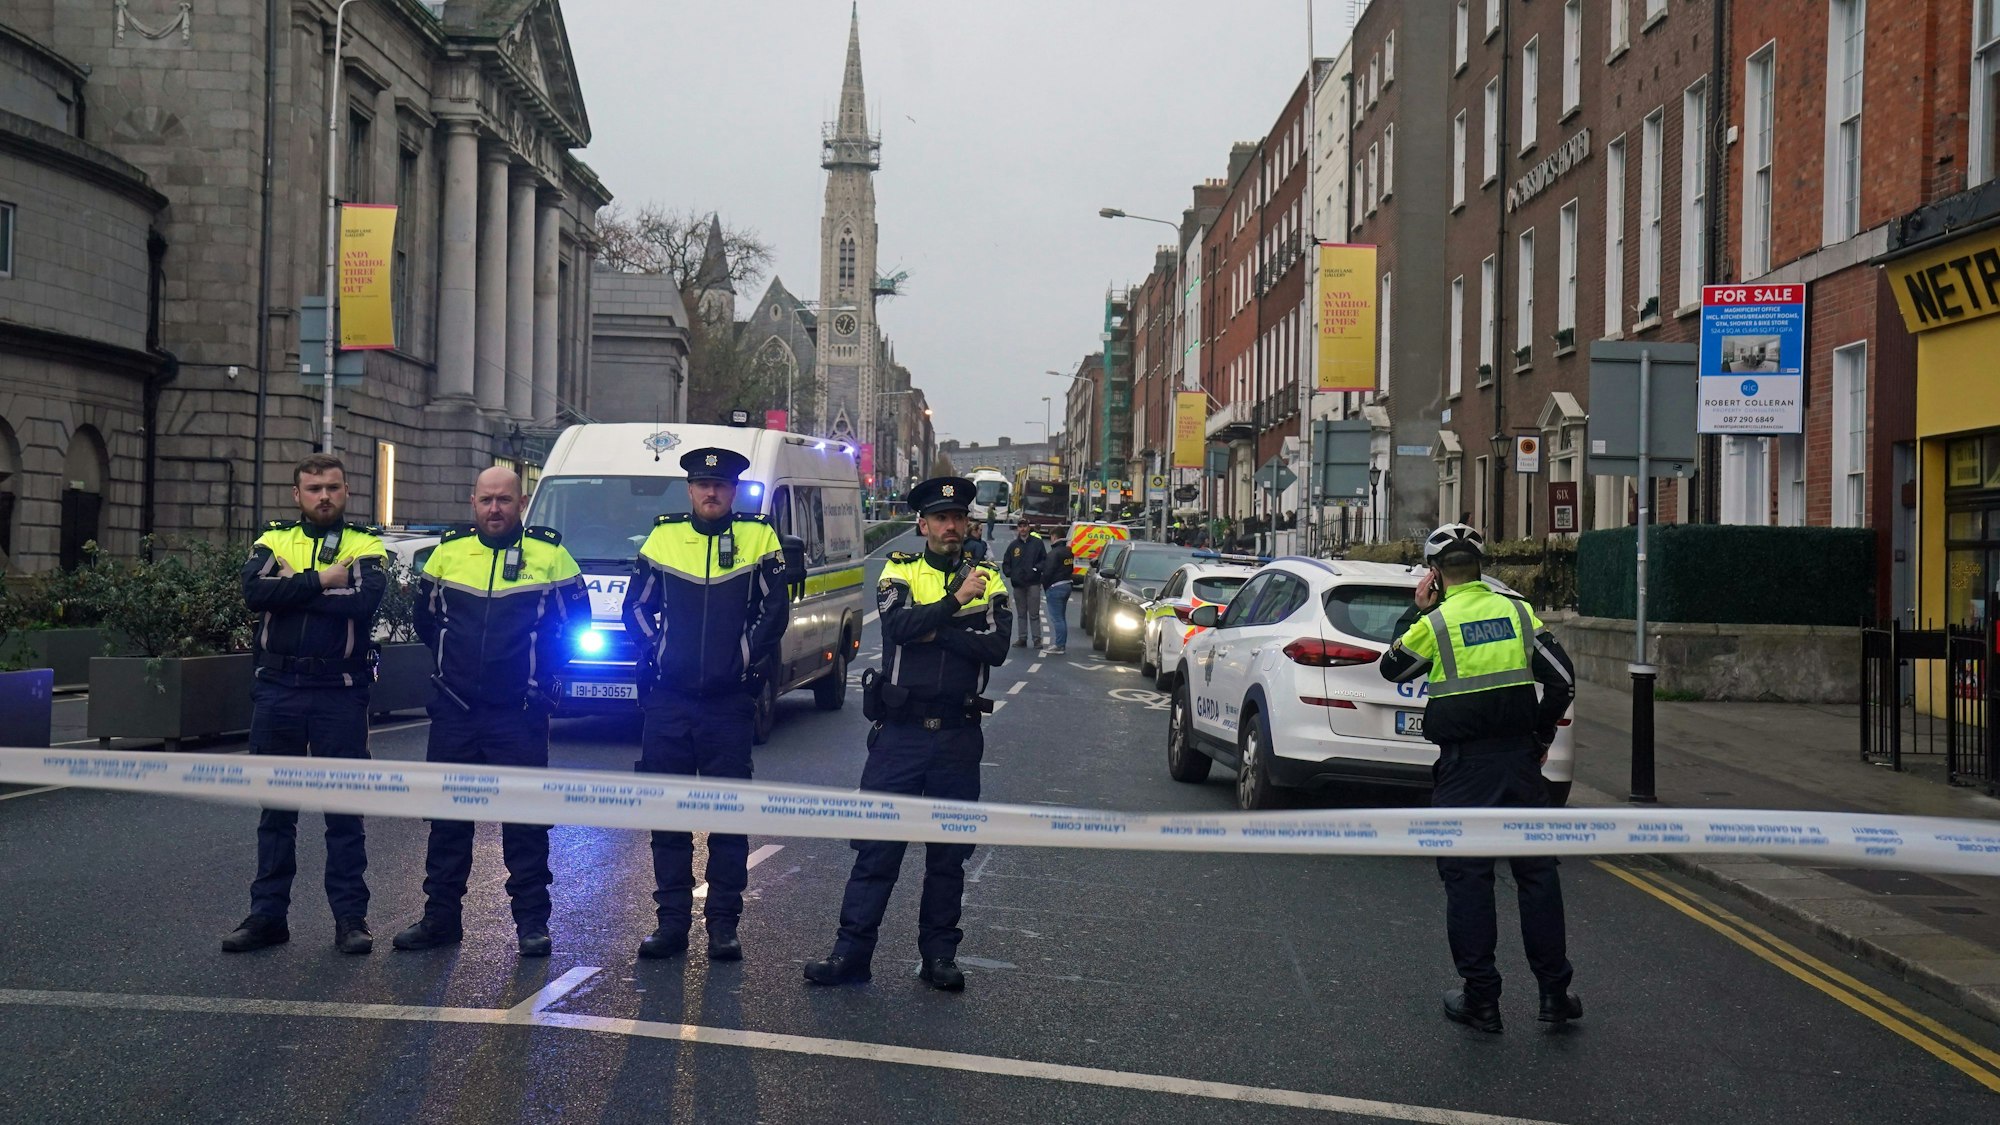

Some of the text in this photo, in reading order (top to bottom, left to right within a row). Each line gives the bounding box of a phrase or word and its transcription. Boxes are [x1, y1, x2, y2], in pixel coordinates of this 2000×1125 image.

[344, 259, 385, 267] WARHOL
[344, 268, 375, 276] THREE
[343, 285, 363, 293] OUT
[1714, 288, 1793, 303] FOR SALE
[1324, 300, 1370, 308] WARHOL
[1705, 399, 1740, 407] ROBERT
[1556, 489, 1569, 500] SIX
[1087, 533, 1115, 541] GARDA
[586, 579, 626, 594] AR
[1463, 620, 1514, 643] GARDA
[576, 685, 632, 698] 191-D-30557
[1334, 689, 1367, 698] HYUNDAI
[1197, 695, 1219, 722] GARDA
[1409, 717, 1424, 730] 20
[330, 771, 365, 782] GARDA
[367, 773, 383, 782] AN
[442, 784, 500, 795] Confidential
[543, 782, 664, 798] COSC AR DHUL ISTEACH
[452, 795, 489, 805] GARDA
[687, 790, 738, 801] NO ENTRY
[564, 794, 642, 808] LÁTHAIR COIRE
[822, 799, 856, 808] GARDA
[858, 801, 873, 809] AN
[882, 801, 895, 809] Tel
[676, 801, 745, 812] CRIME SCENE
[761, 804, 901, 820] UIMHIR THEILEAFÓIN RÚNDA
[932, 812, 988, 823] Confidential
[940, 823, 977, 833] GARDA
[1050, 821, 1126, 833] LÁTHAIR COIRE
[1160, 826, 1227, 836] CRIME SCENE
[1503, 822, 1616, 831] COSC AR DHUL ISTEACH
[1637, 822, 1684, 832] NO ENTRY
[1756, 825, 1788, 834] GARDA
[1790, 826, 1803, 834] AN
[1278, 829, 1341, 839] THEILEAFÓIN
[1343, 830, 1378, 838] UIMHIR
[1408, 827, 1463, 838] Confidential
[1524, 832, 1597, 843] LÁTHAIR COIRE
[1418, 838, 1454, 848] GARDA
[1628, 833, 1660, 843] SCENE
